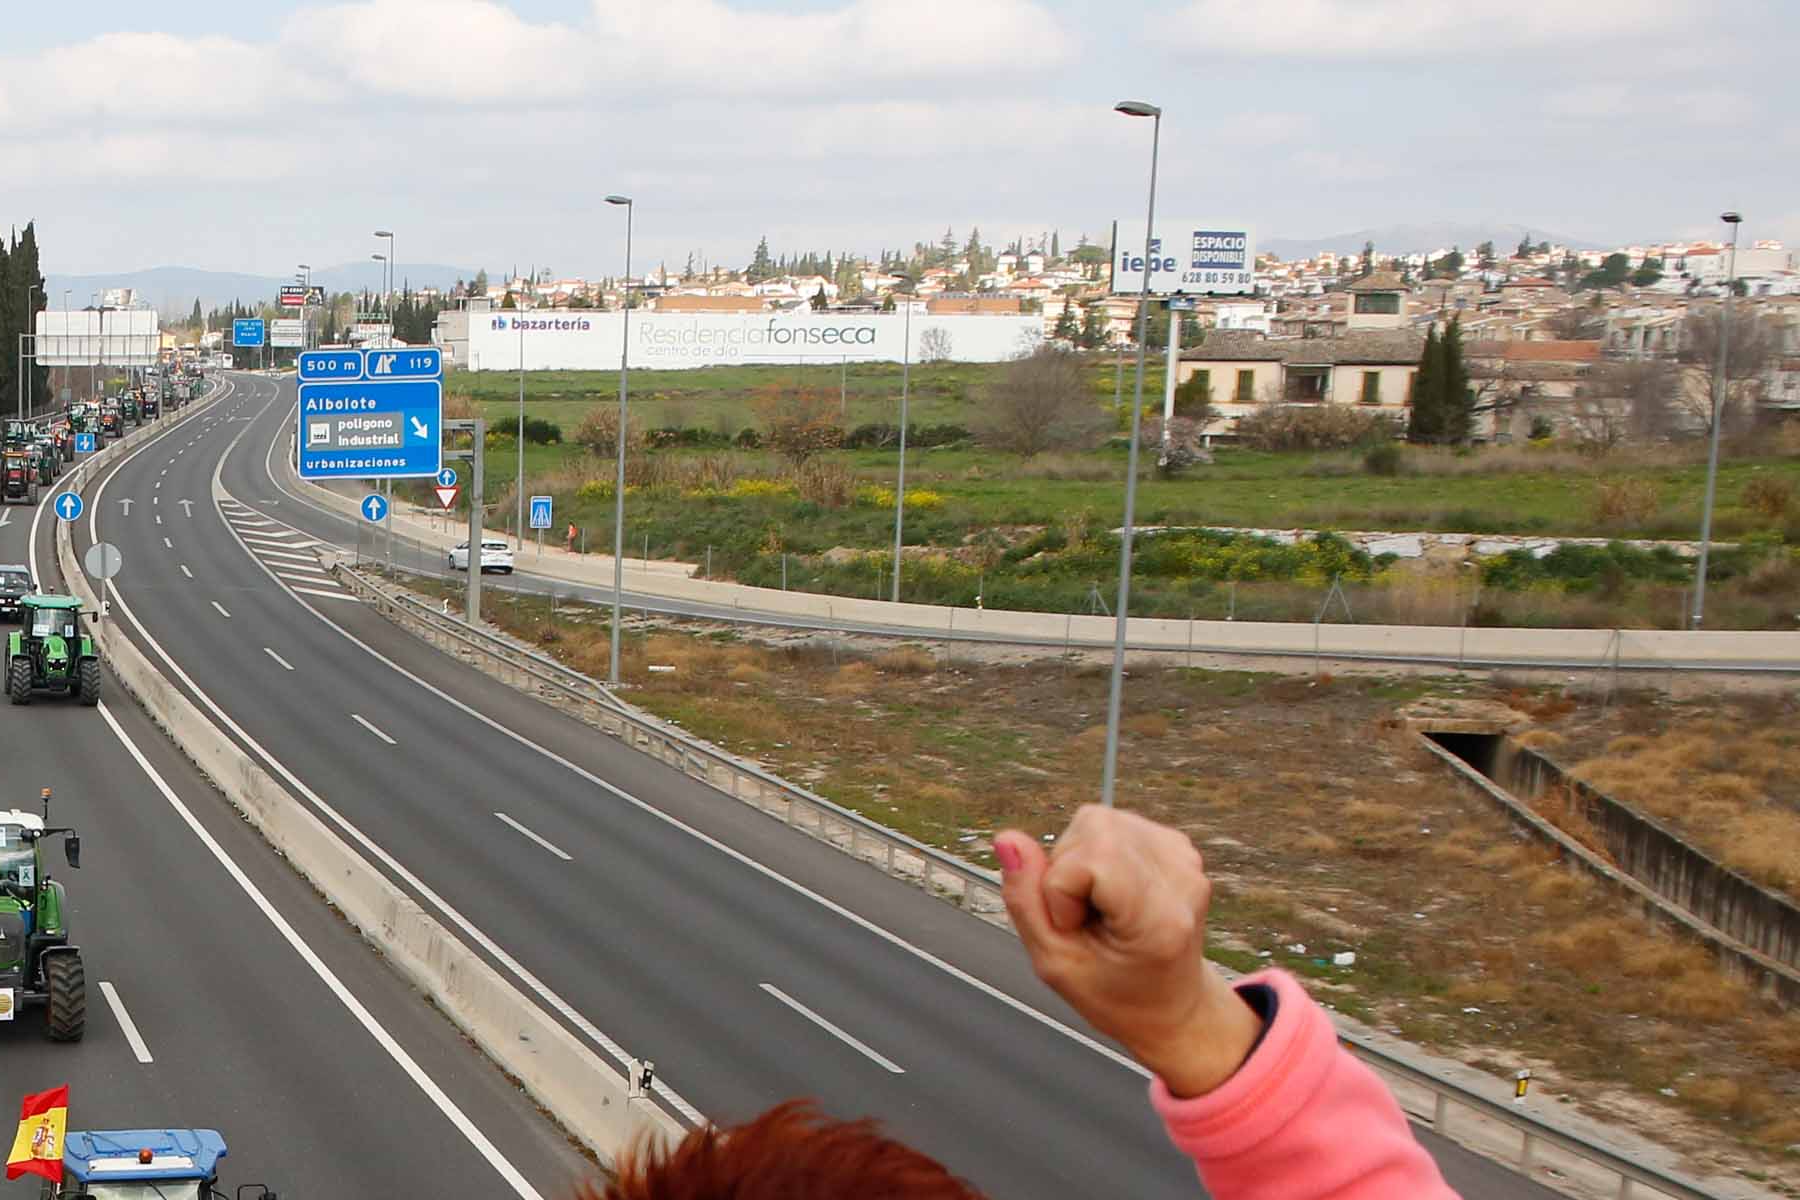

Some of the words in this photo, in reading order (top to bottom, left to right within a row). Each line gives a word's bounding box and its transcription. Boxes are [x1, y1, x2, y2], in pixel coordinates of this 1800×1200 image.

[1194, 236, 1245, 249] ESPACIO
[1192, 250, 1243, 263] DISPONIBLE
[1182, 272, 1202, 283] 628
[1205, 272, 1218, 283] 80
[1221, 272, 1234, 283] 59
[1238, 272, 1251, 284] 80
[512, 317, 590, 330] bazartería
[307, 361, 337, 371] 500
[344, 362, 356, 370] m
[410, 358, 432, 369] 119
[306, 397, 377, 410] Albolote
[338, 433, 399, 446] industrial
[306, 457, 406, 469] urbanizaciones
